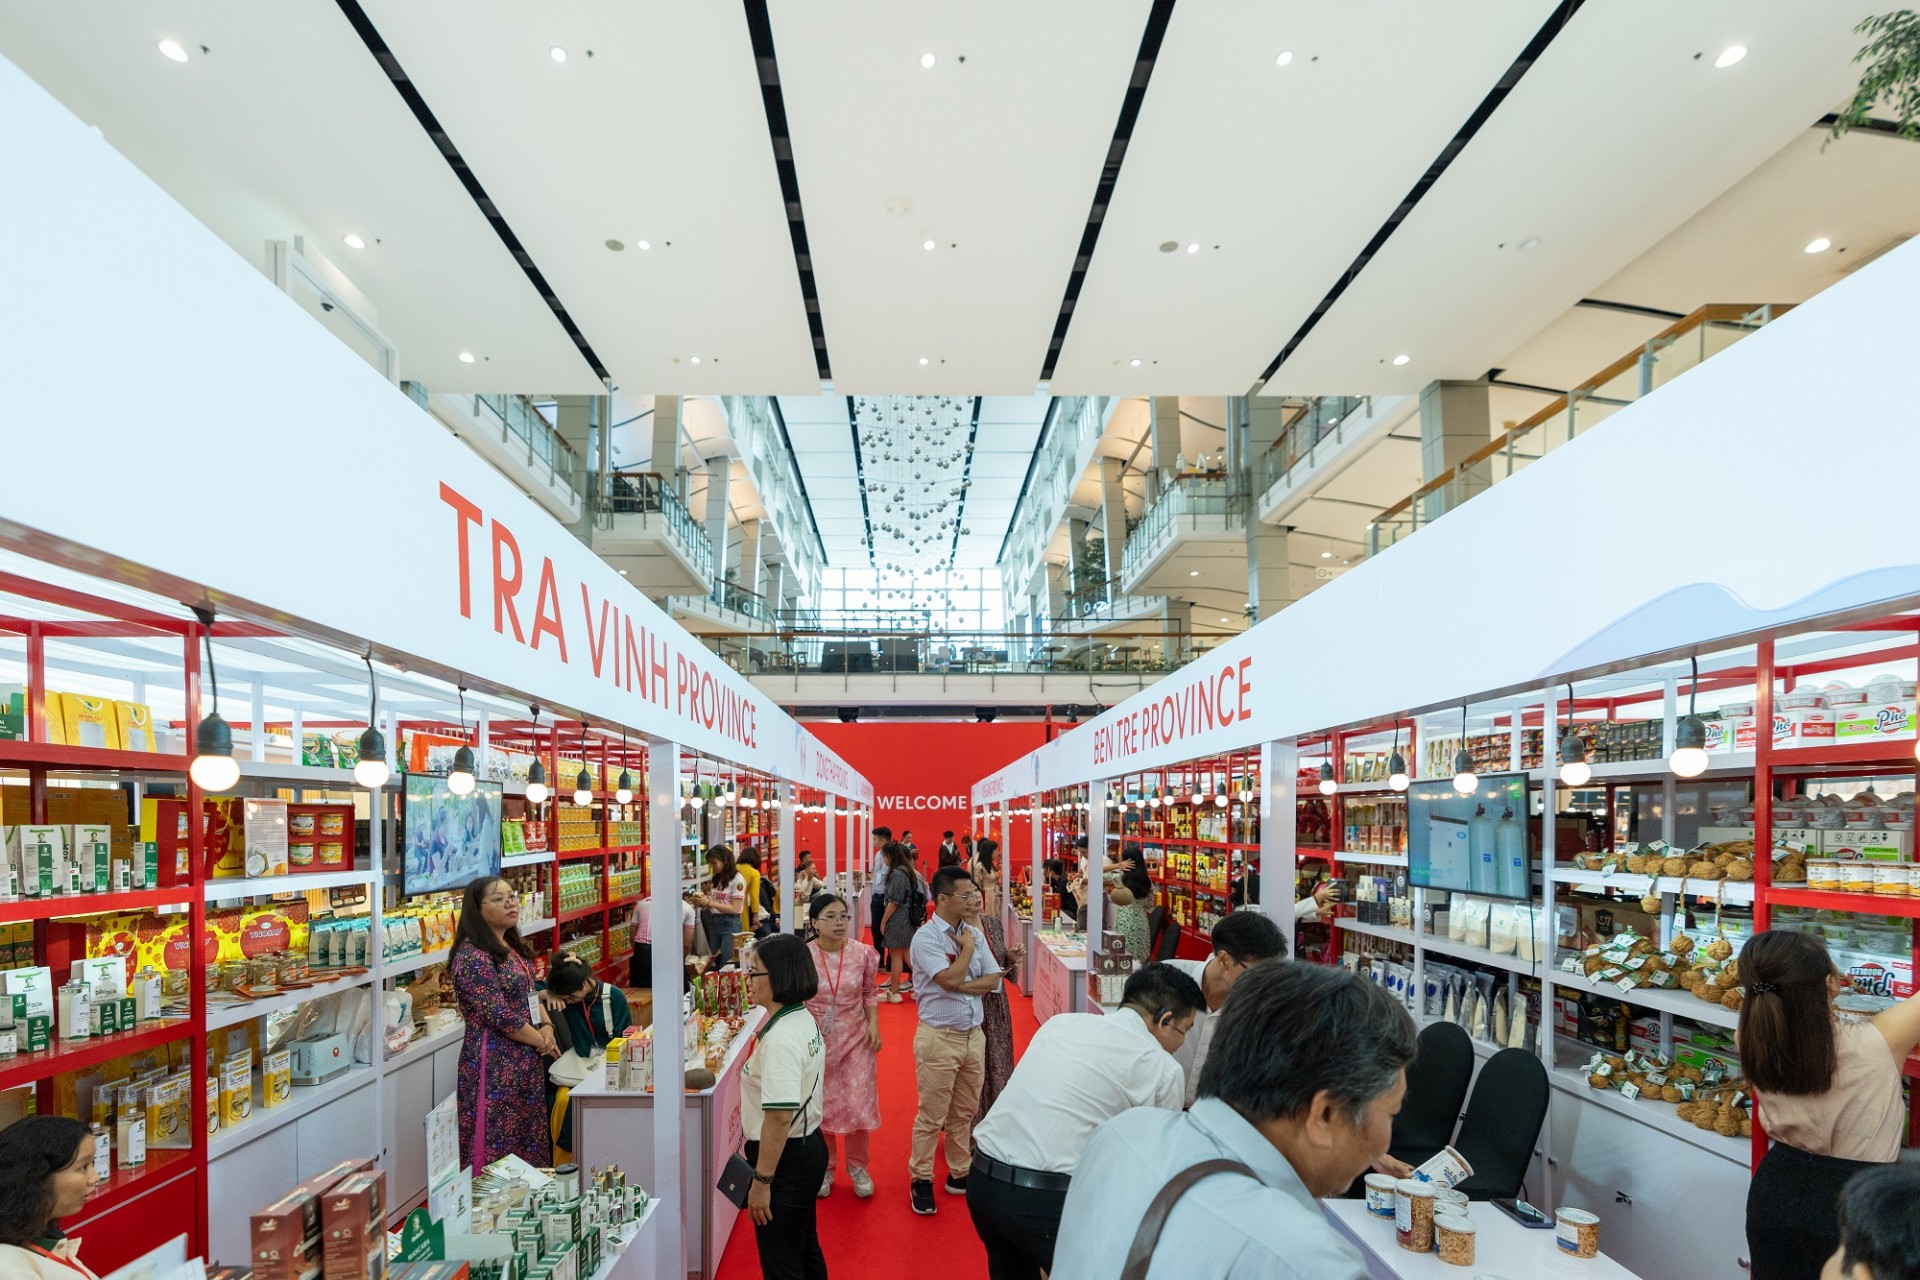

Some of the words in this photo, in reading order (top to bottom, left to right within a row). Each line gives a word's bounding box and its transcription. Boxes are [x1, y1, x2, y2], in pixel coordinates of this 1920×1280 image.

[439, 480, 568, 664] TRA
[580, 582, 669, 709] VINH
[677, 651, 757, 749] PROVINCE
[1094, 723, 1114, 765] BEN
[1116, 712, 1138, 759] TRE
[1142, 656, 1252, 751] PROVINCE
[876, 795, 967, 810] WELCOME
